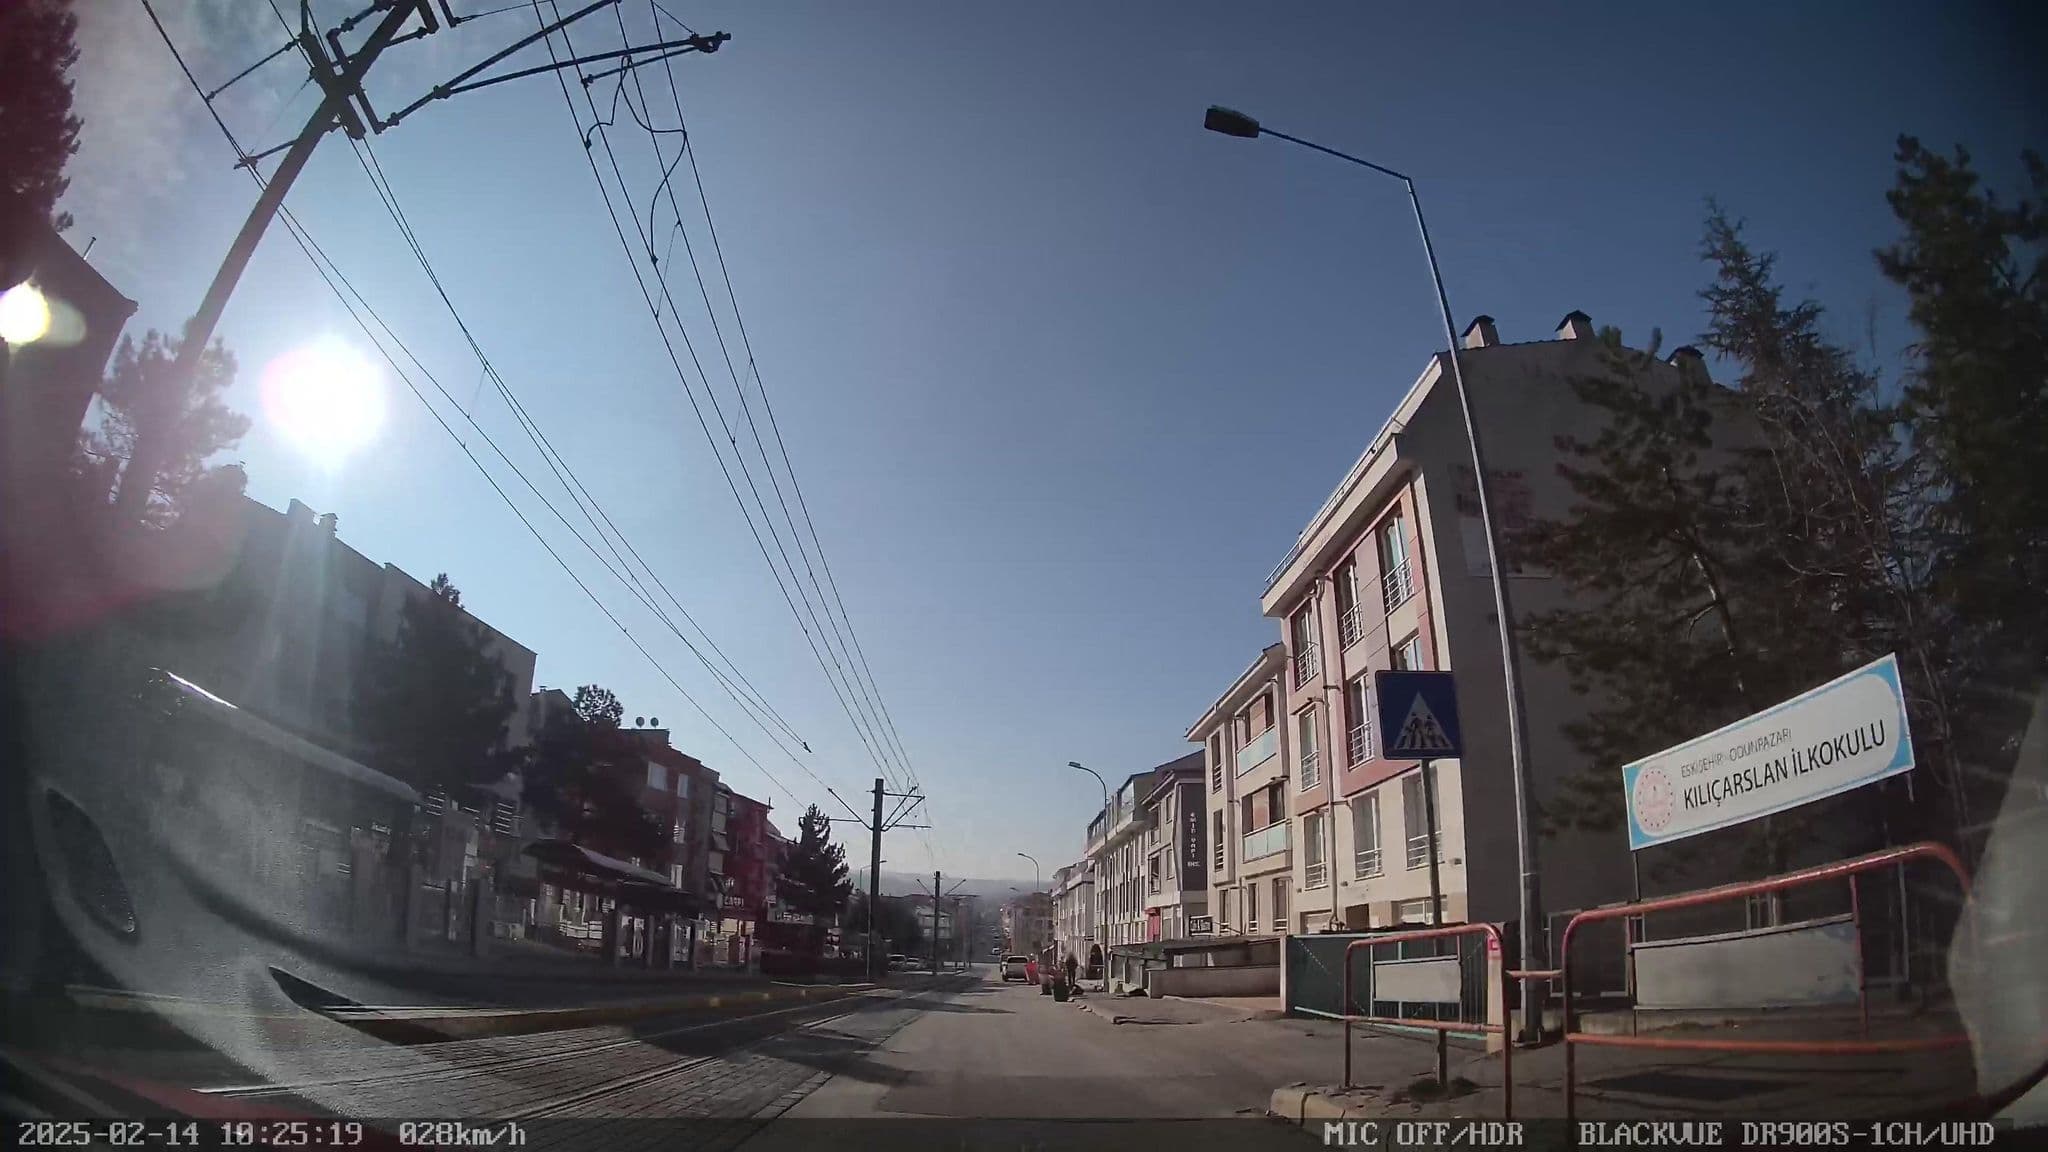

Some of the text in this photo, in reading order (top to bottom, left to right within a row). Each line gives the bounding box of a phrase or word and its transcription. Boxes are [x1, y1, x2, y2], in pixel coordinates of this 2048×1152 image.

[1683, 718, 1885, 810] KILIÇARSLAN İLKOKULU
[1729, 728, 1792, 762] ODUNPAZARI
